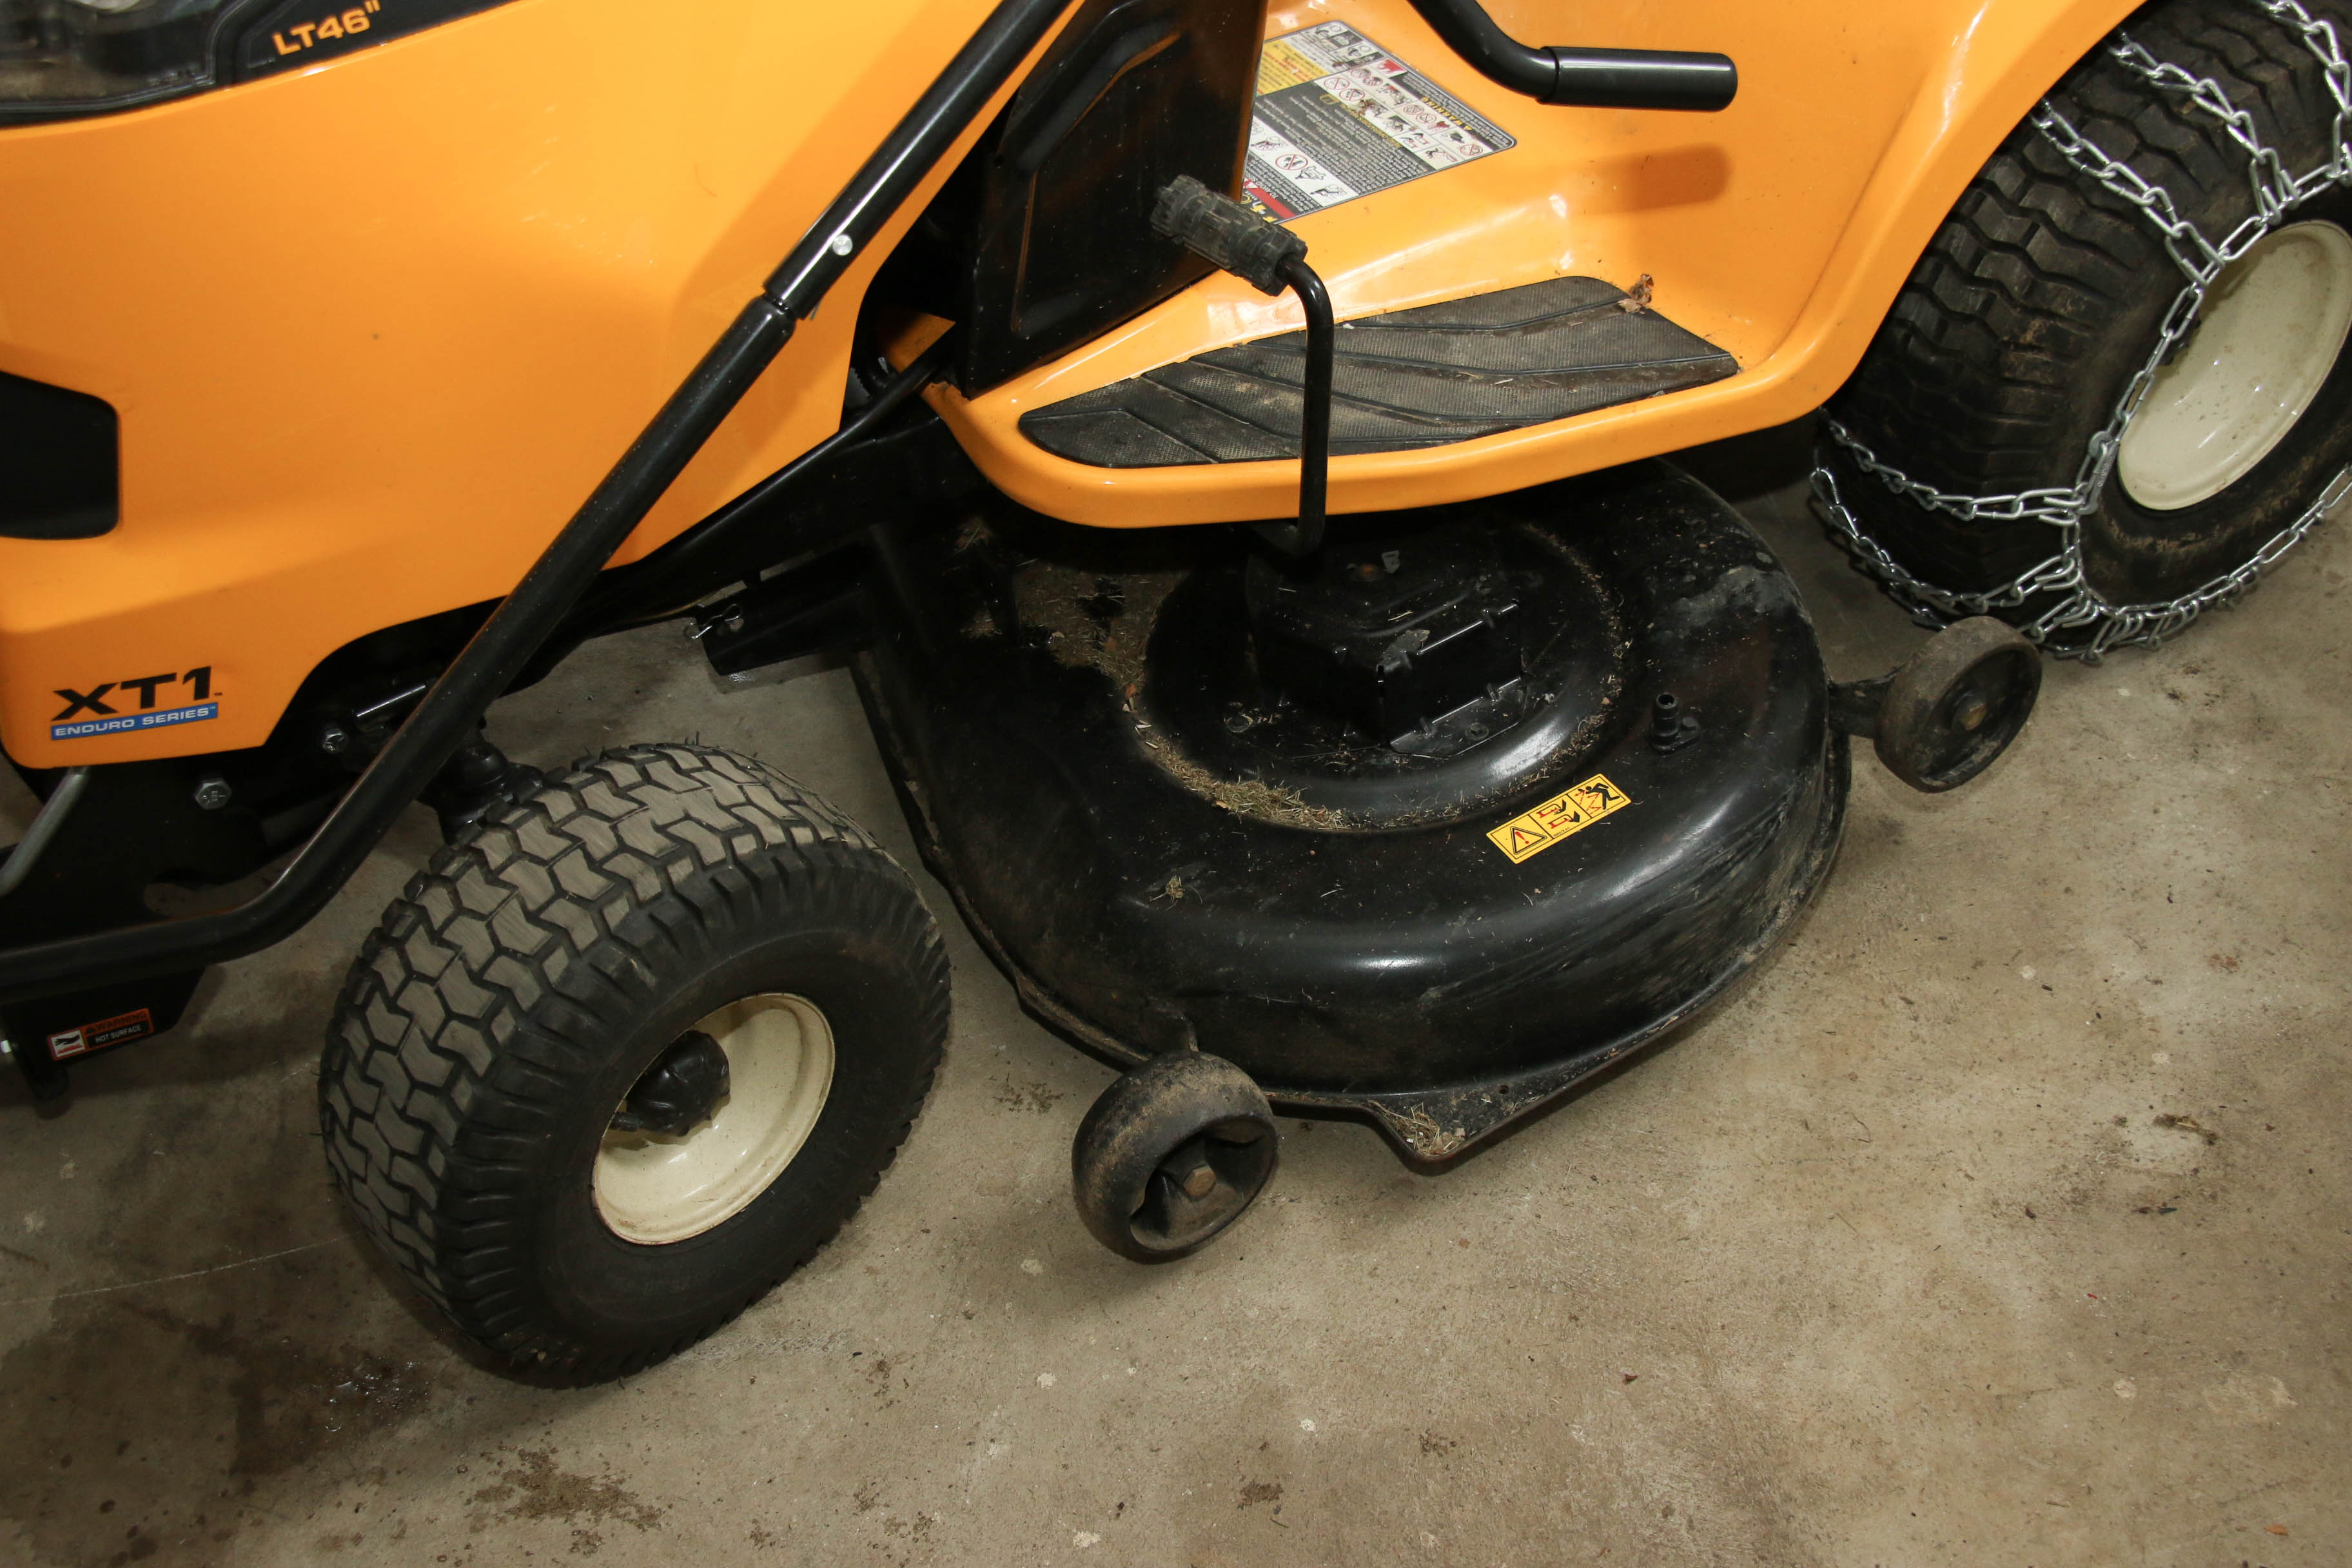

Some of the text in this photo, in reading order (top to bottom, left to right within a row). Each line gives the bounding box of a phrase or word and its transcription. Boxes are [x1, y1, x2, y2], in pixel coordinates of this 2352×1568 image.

[272, 0, 380, 55] LT46"
[1420, 96, 1464, 126] WARNING
[51, 666, 211, 721] XT1
[55, 707, 210, 736] ENDURO SERIES
[95, 1024, 142, 1043] HOT SURFACE
[97, 1011, 146, 1030] WARNING
